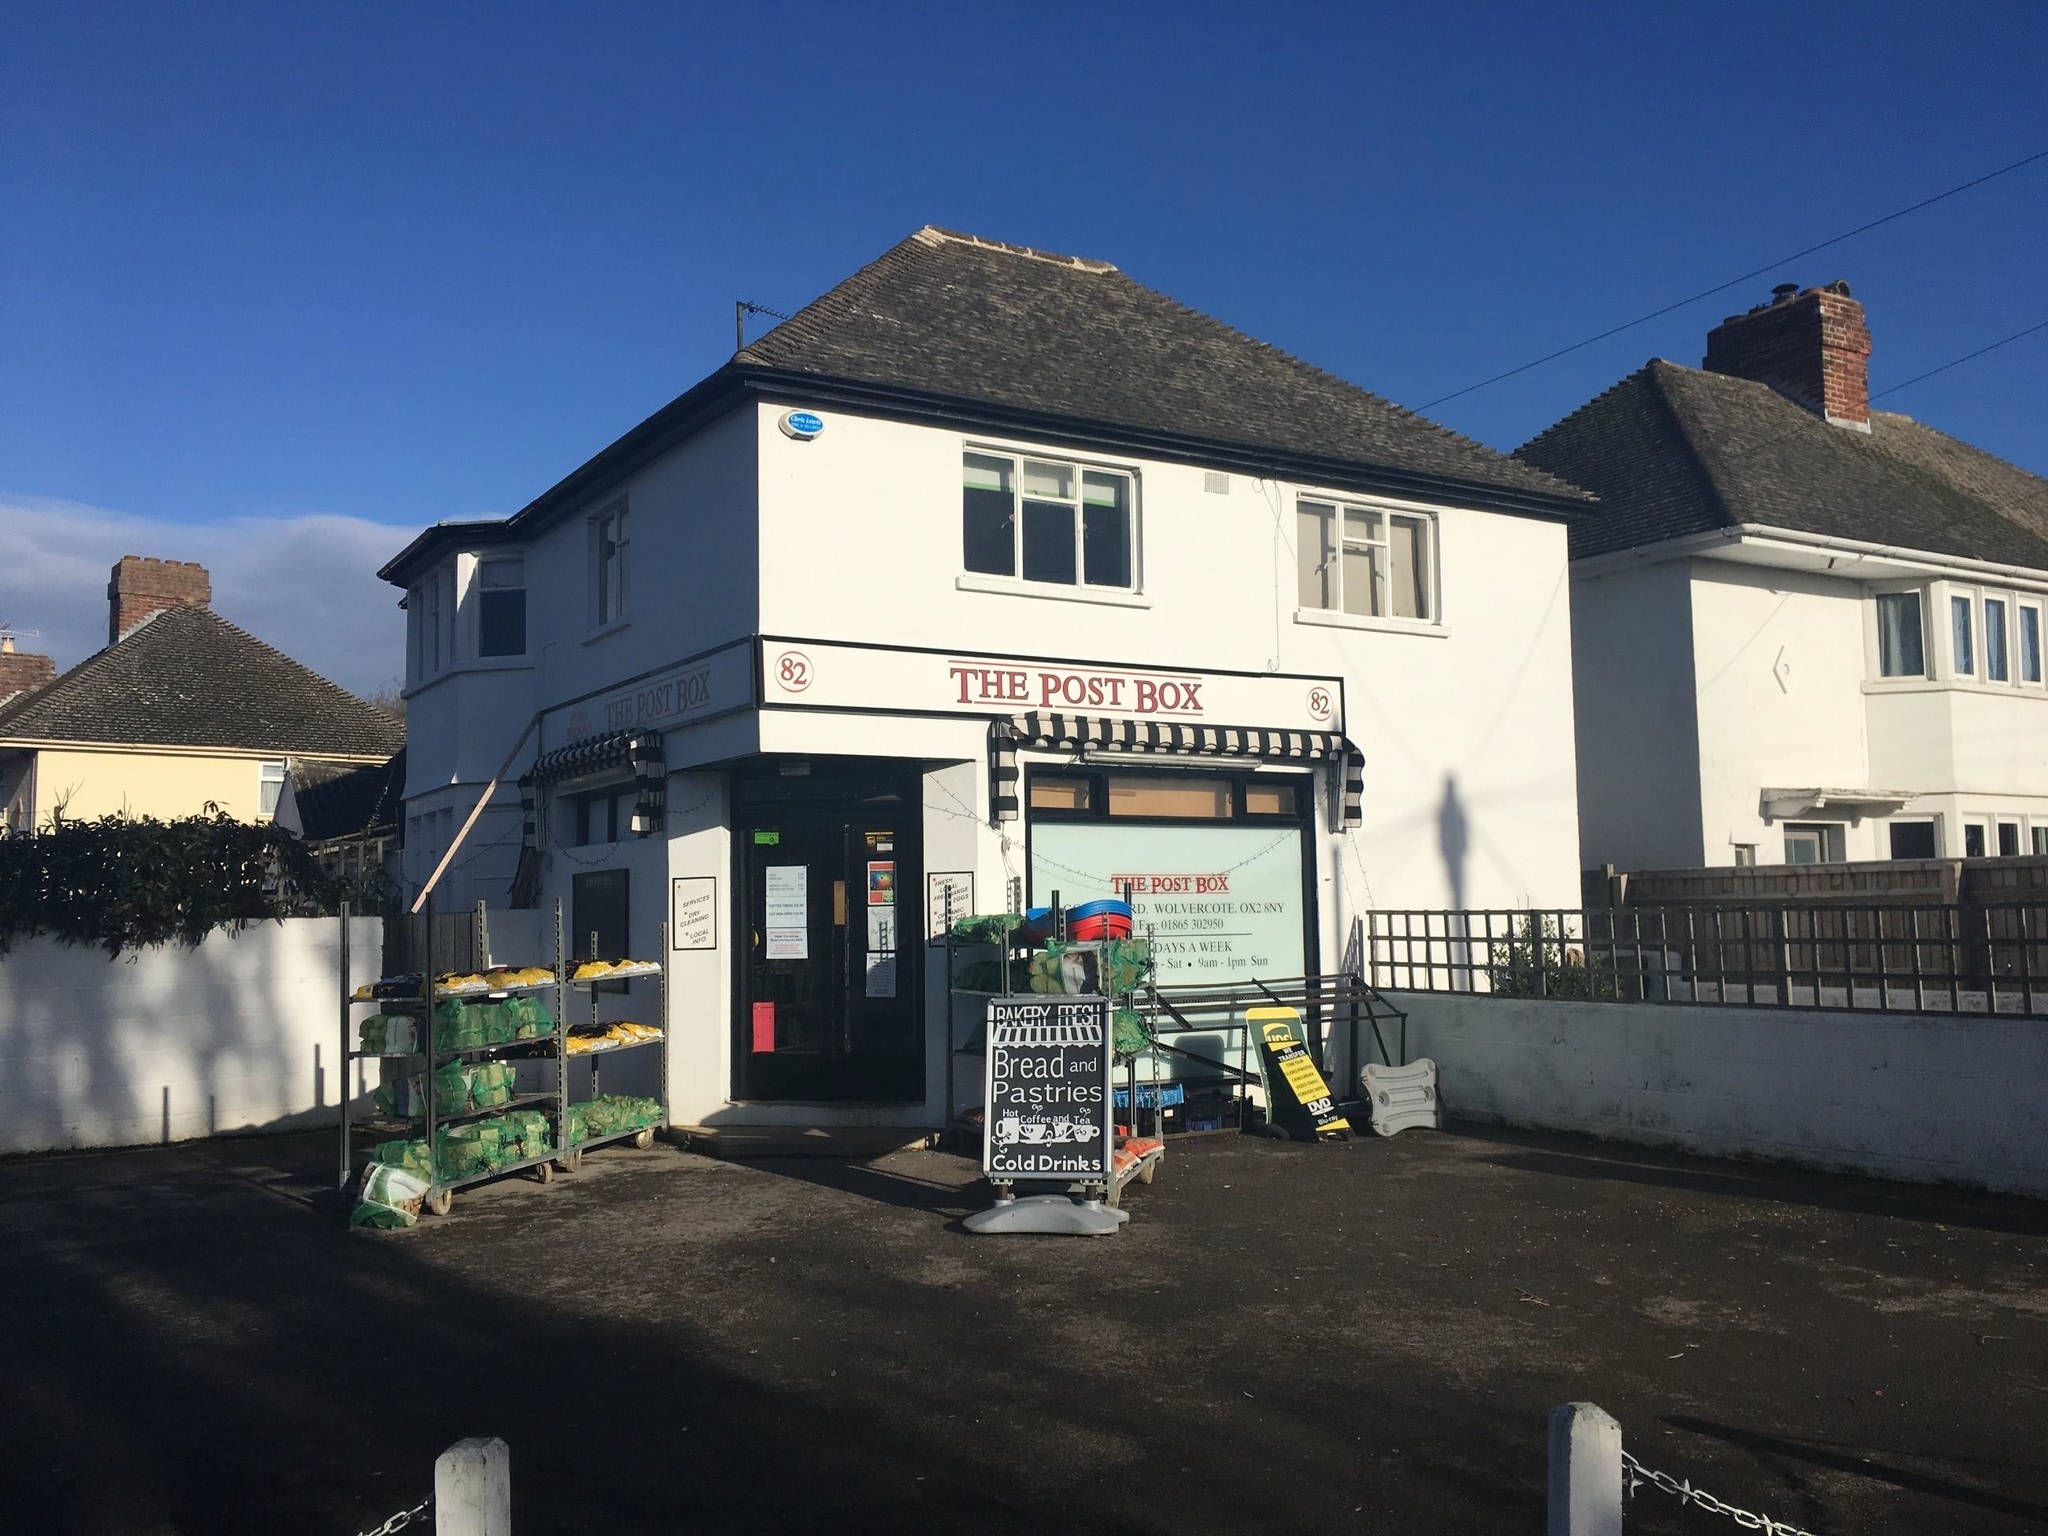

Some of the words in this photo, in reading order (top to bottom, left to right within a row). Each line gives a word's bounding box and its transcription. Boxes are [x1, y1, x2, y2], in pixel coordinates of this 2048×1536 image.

[780, 658, 807, 687] 82
[950, 667, 1029, 703] THE
[1038, 673, 1125, 708] POST
[1134, 679, 1203, 713] BOX
[605, 697, 633, 729] THE
[636, 684, 672, 726] POST
[676, 671, 710, 713] BOX
[1310, 694, 1330, 715] 82
[935, 877, 953, 887] FRESH
[1151, 876, 1191, 894] POST
[1195, 876, 1229, 893] BOX
[682, 894, 710, 908] SERVICES
[953, 893, 969, 903] EGGS
[688, 910, 700, 919] DRY
[1240, 903, 1262, 914] OX2
[1264, 902, 1285, 914] 8NY
[679, 913, 709, 928] CLEANING
[1161, 919, 1189, 931] 01865
[1191, 918, 1224, 930] 302950
[690, 929, 709, 939] LOCAL
[691, 936, 706, 945] INFO
[1154, 942, 1186, 954] DAYS
[1188, 942, 1197, 953] A
[1200, 940, 1232, 952] WEEK
[1167, 959, 1182, 969] Sat
[1198, 957, 1218, 968] 9am
[1227, 957, 1246, 970] 1pm
[1251, 955, 1268, 967] Sun
[996, 1006, 1051, 1027] BAKERY
[1058, 1004, 1100, 1026] FRESH
[1278, 1049, 1306, 1062] TRANSFER
[994, 1048, 1064, 1079] Bread
[1069, 1057, 1097, 1073] and
[993, 1081, 1102, 1104] Pastries
[1307, 1098, 1331, 1113] DVD
[1002, 1108, 1018, 1118] Hot
[1020, 1114, 1051, 1124] Coffee
[1053, 1114, 1070, 1124] and
[1073, 1115, 1091, 1125] Tea
[992, 1154, 1036, 1172] Cold
[1039, 1154, 1101, 1172] Drinks
